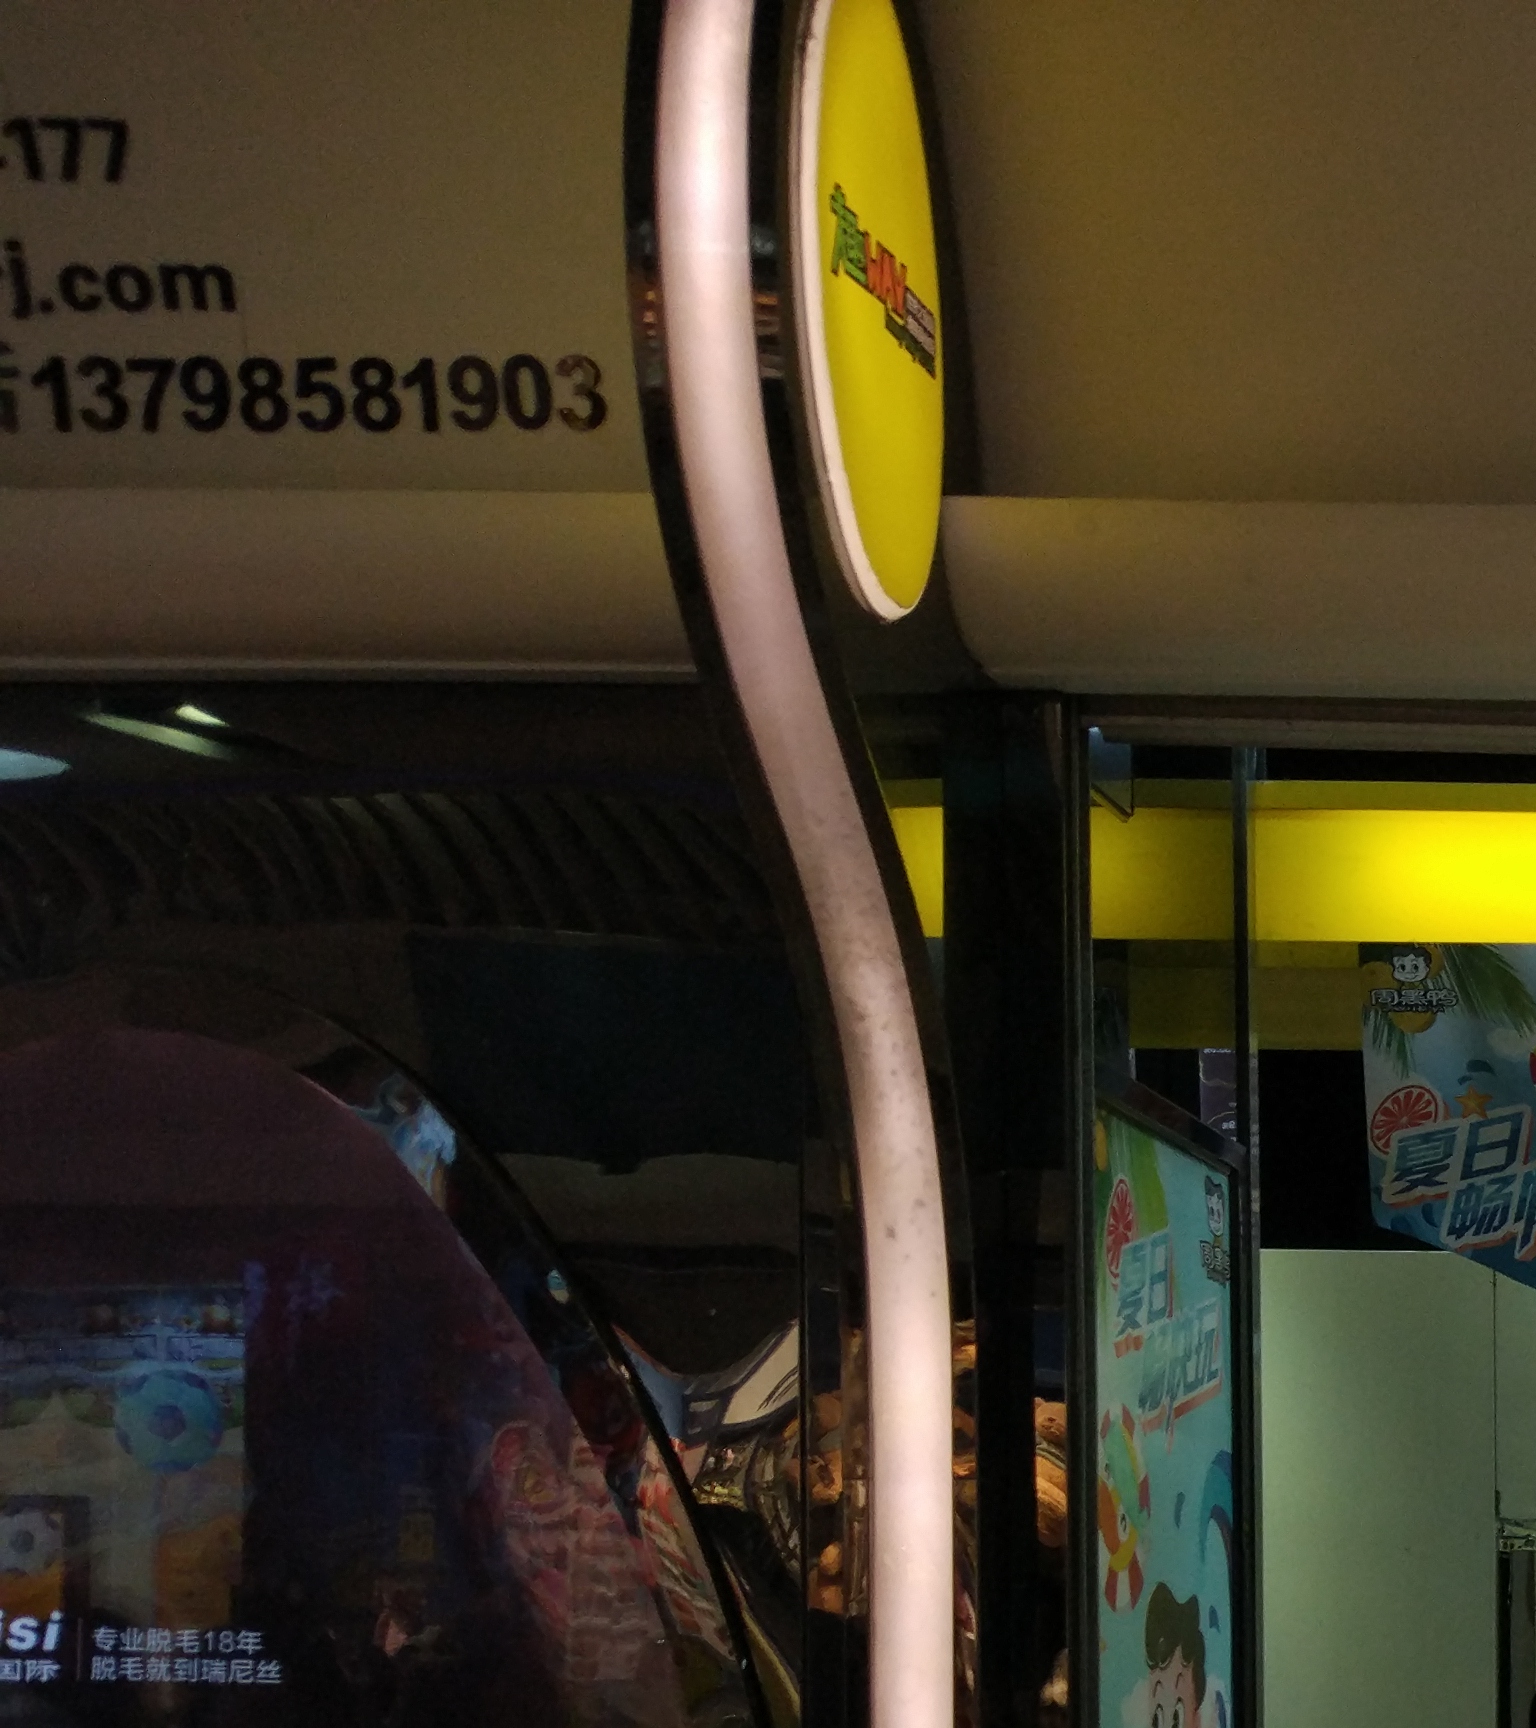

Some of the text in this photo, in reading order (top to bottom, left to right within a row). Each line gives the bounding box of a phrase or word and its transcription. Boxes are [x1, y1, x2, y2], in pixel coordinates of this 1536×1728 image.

[0, 115, 129, 183] 177
[0, 240, 238, 320] j.com
[0, 345, 607, 434] 13798581903
[1392, 1113, 1525, 1198] 夏日
[91, 1657, 284, 1685] 脱毛就到瑞尼丝
[93, 1626, 266, 1655] 专业脱毛18年
